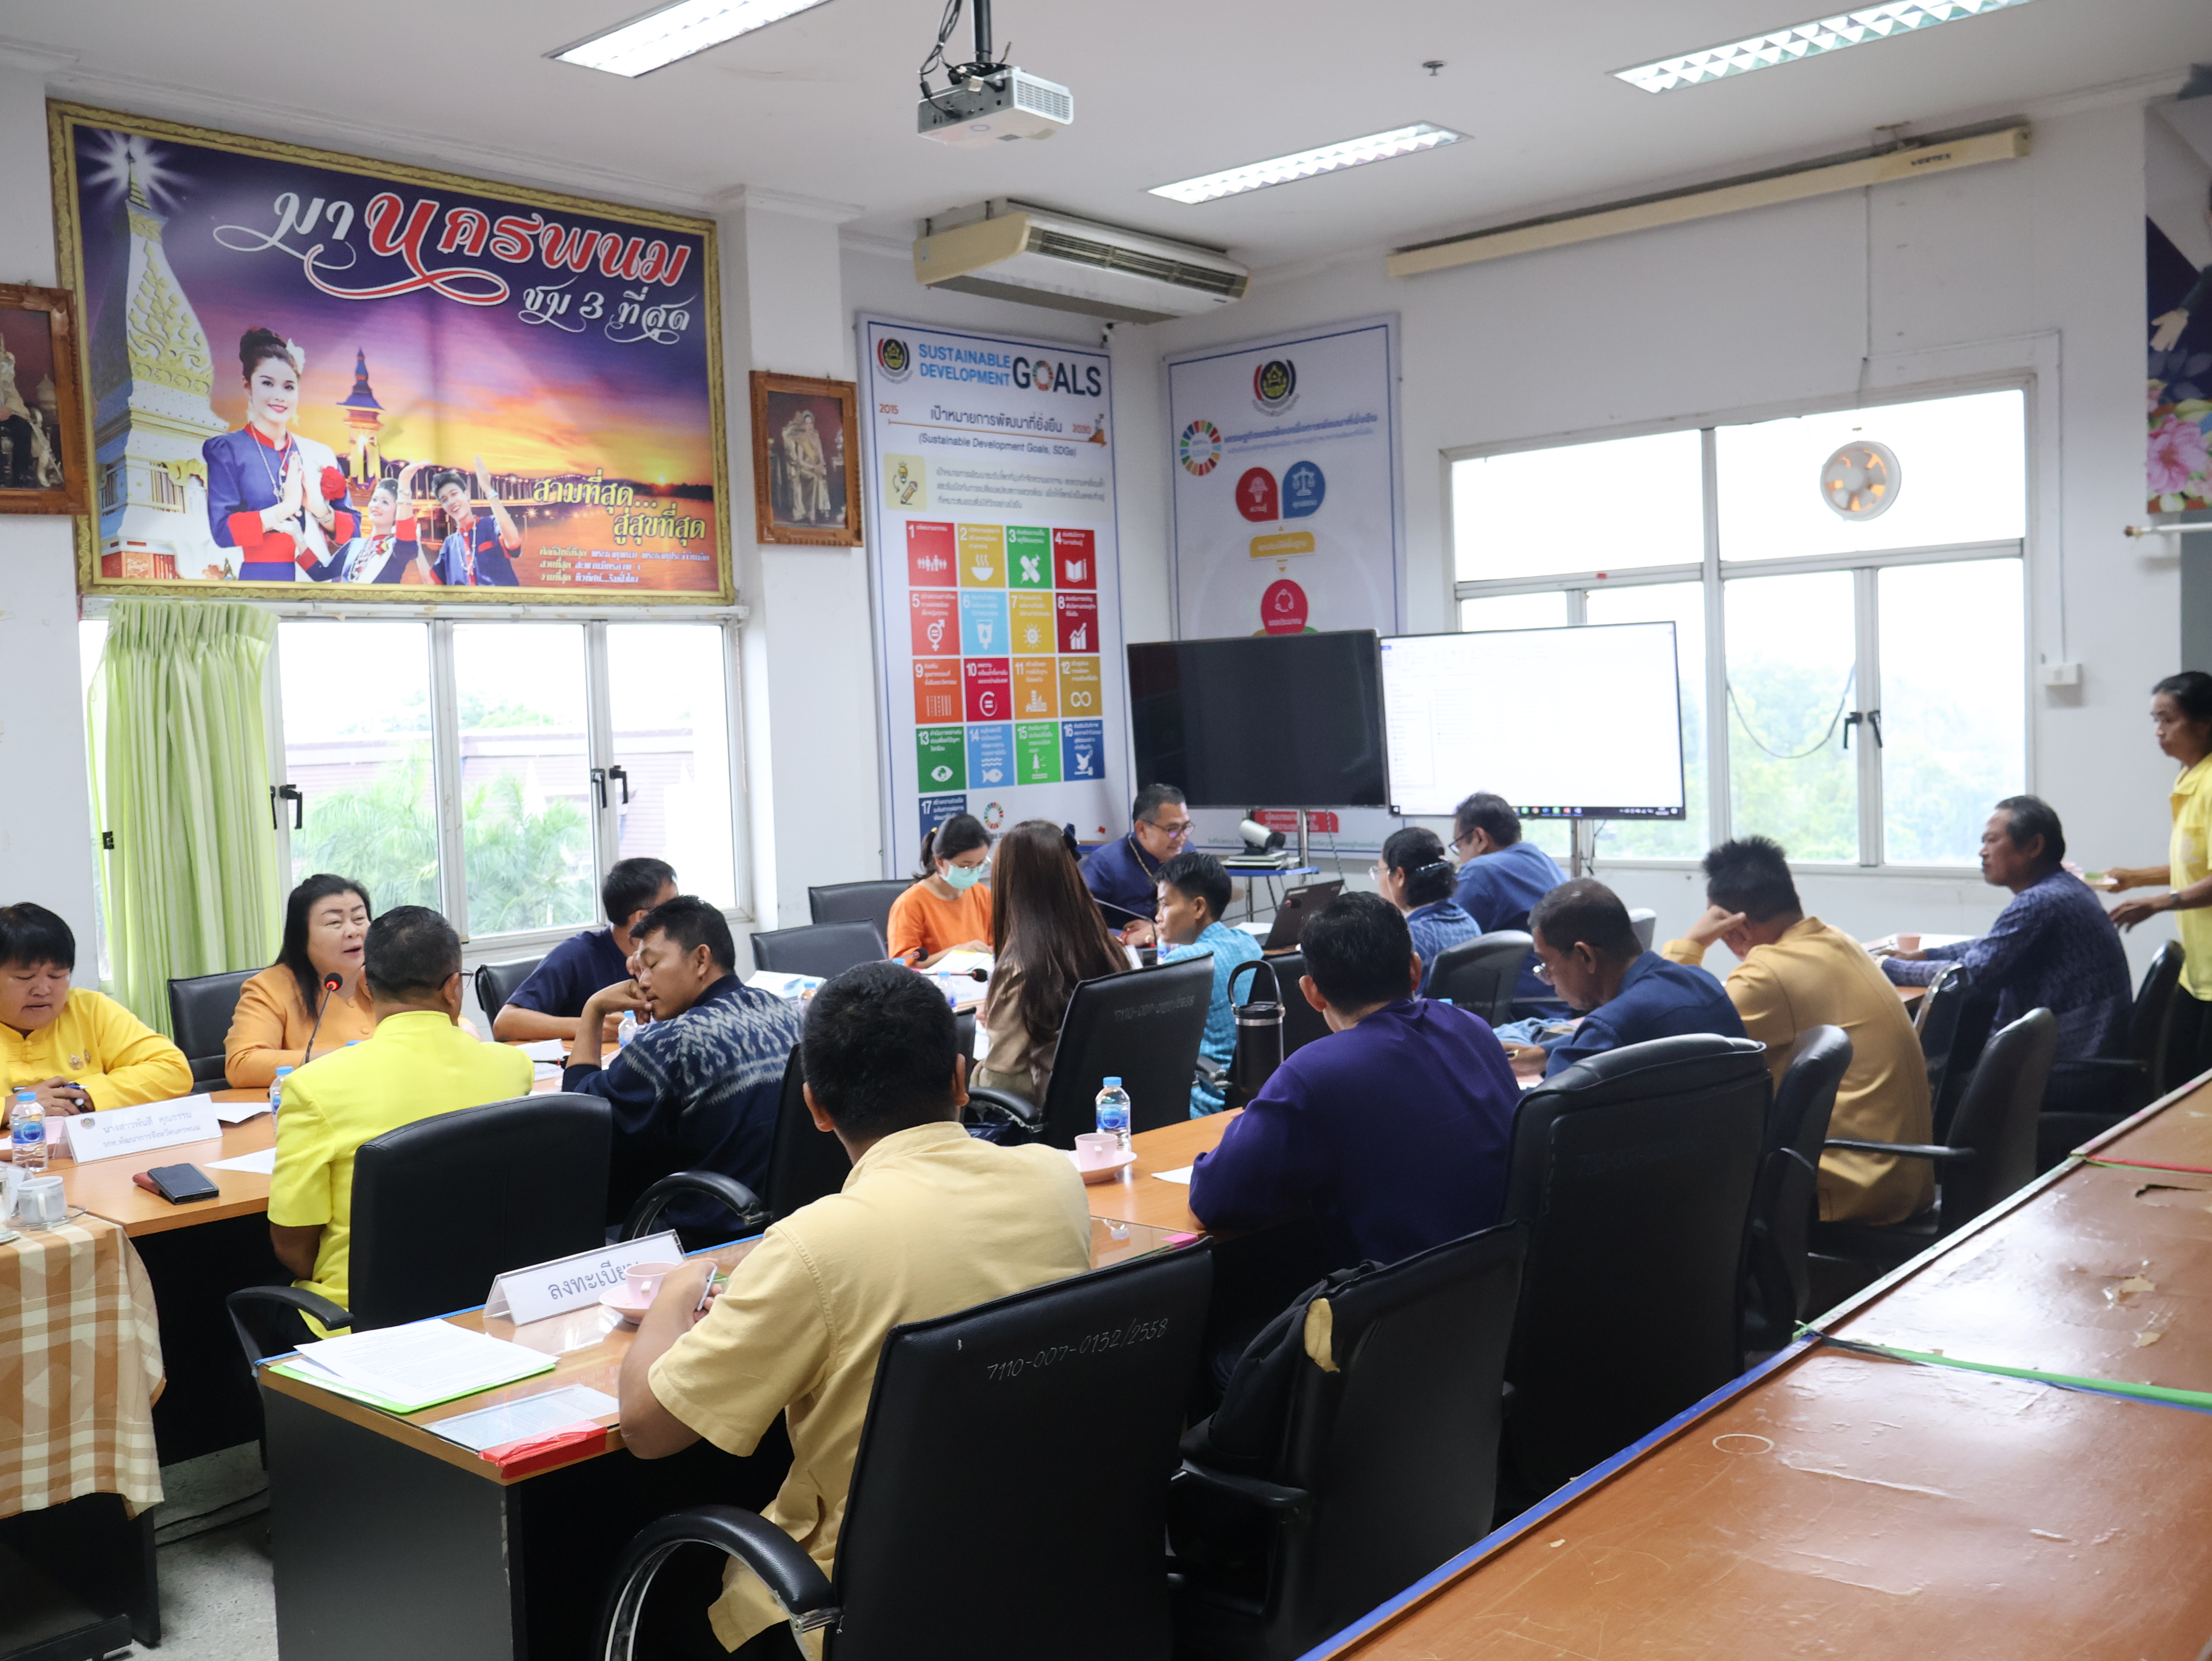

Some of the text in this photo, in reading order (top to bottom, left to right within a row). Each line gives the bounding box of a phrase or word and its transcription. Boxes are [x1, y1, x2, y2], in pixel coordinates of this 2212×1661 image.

[304, 192, 692, 306] นครพนม
[519, 275, 698, 344] ชม 3 ที่สุด
[919, 344, 1011, 369] SUSTAINABLE
[920, 356, 1102, 397] DEVELOPMENT GOALS
[879, 403, 899, 415] 2015
[930, 405, 1063, 433] เป้าหมายการพัฒนาที่ยั่งยืน
[918, 433, 971, 448] (Sustainable
[973, 439, 1025, 453] Development
[908, 525, 915, 539] 1
[959, 527, 968, 541] 2
[1008, 529, 1017, 543] 3
[1055, 531, 1063, 545] 4
[912, 593, 920, 608] 5
[962, 595, 971, 608] 6
[1011, 595, 1018, 608] 7
[1057, 596, 1066, 610] 8
[915, 663, 924, 678] 9
[966, 662, 977, 677] 10
[1015, 662, 1025, 675] 11
[1060, 661, 1071, 674] 12
[918, 730, 930, 745] 13
[969, 728, 980, 742] 14
[1016, 725, 1028, 740] 15
[1063, 723, 1074, 737] 16
[920, 800, 932, 815] 17
[548, 1260, 639, 1300] ลงทะเบีย
[987, 1318, 1169, 1381] 7110-007-0132/2558
